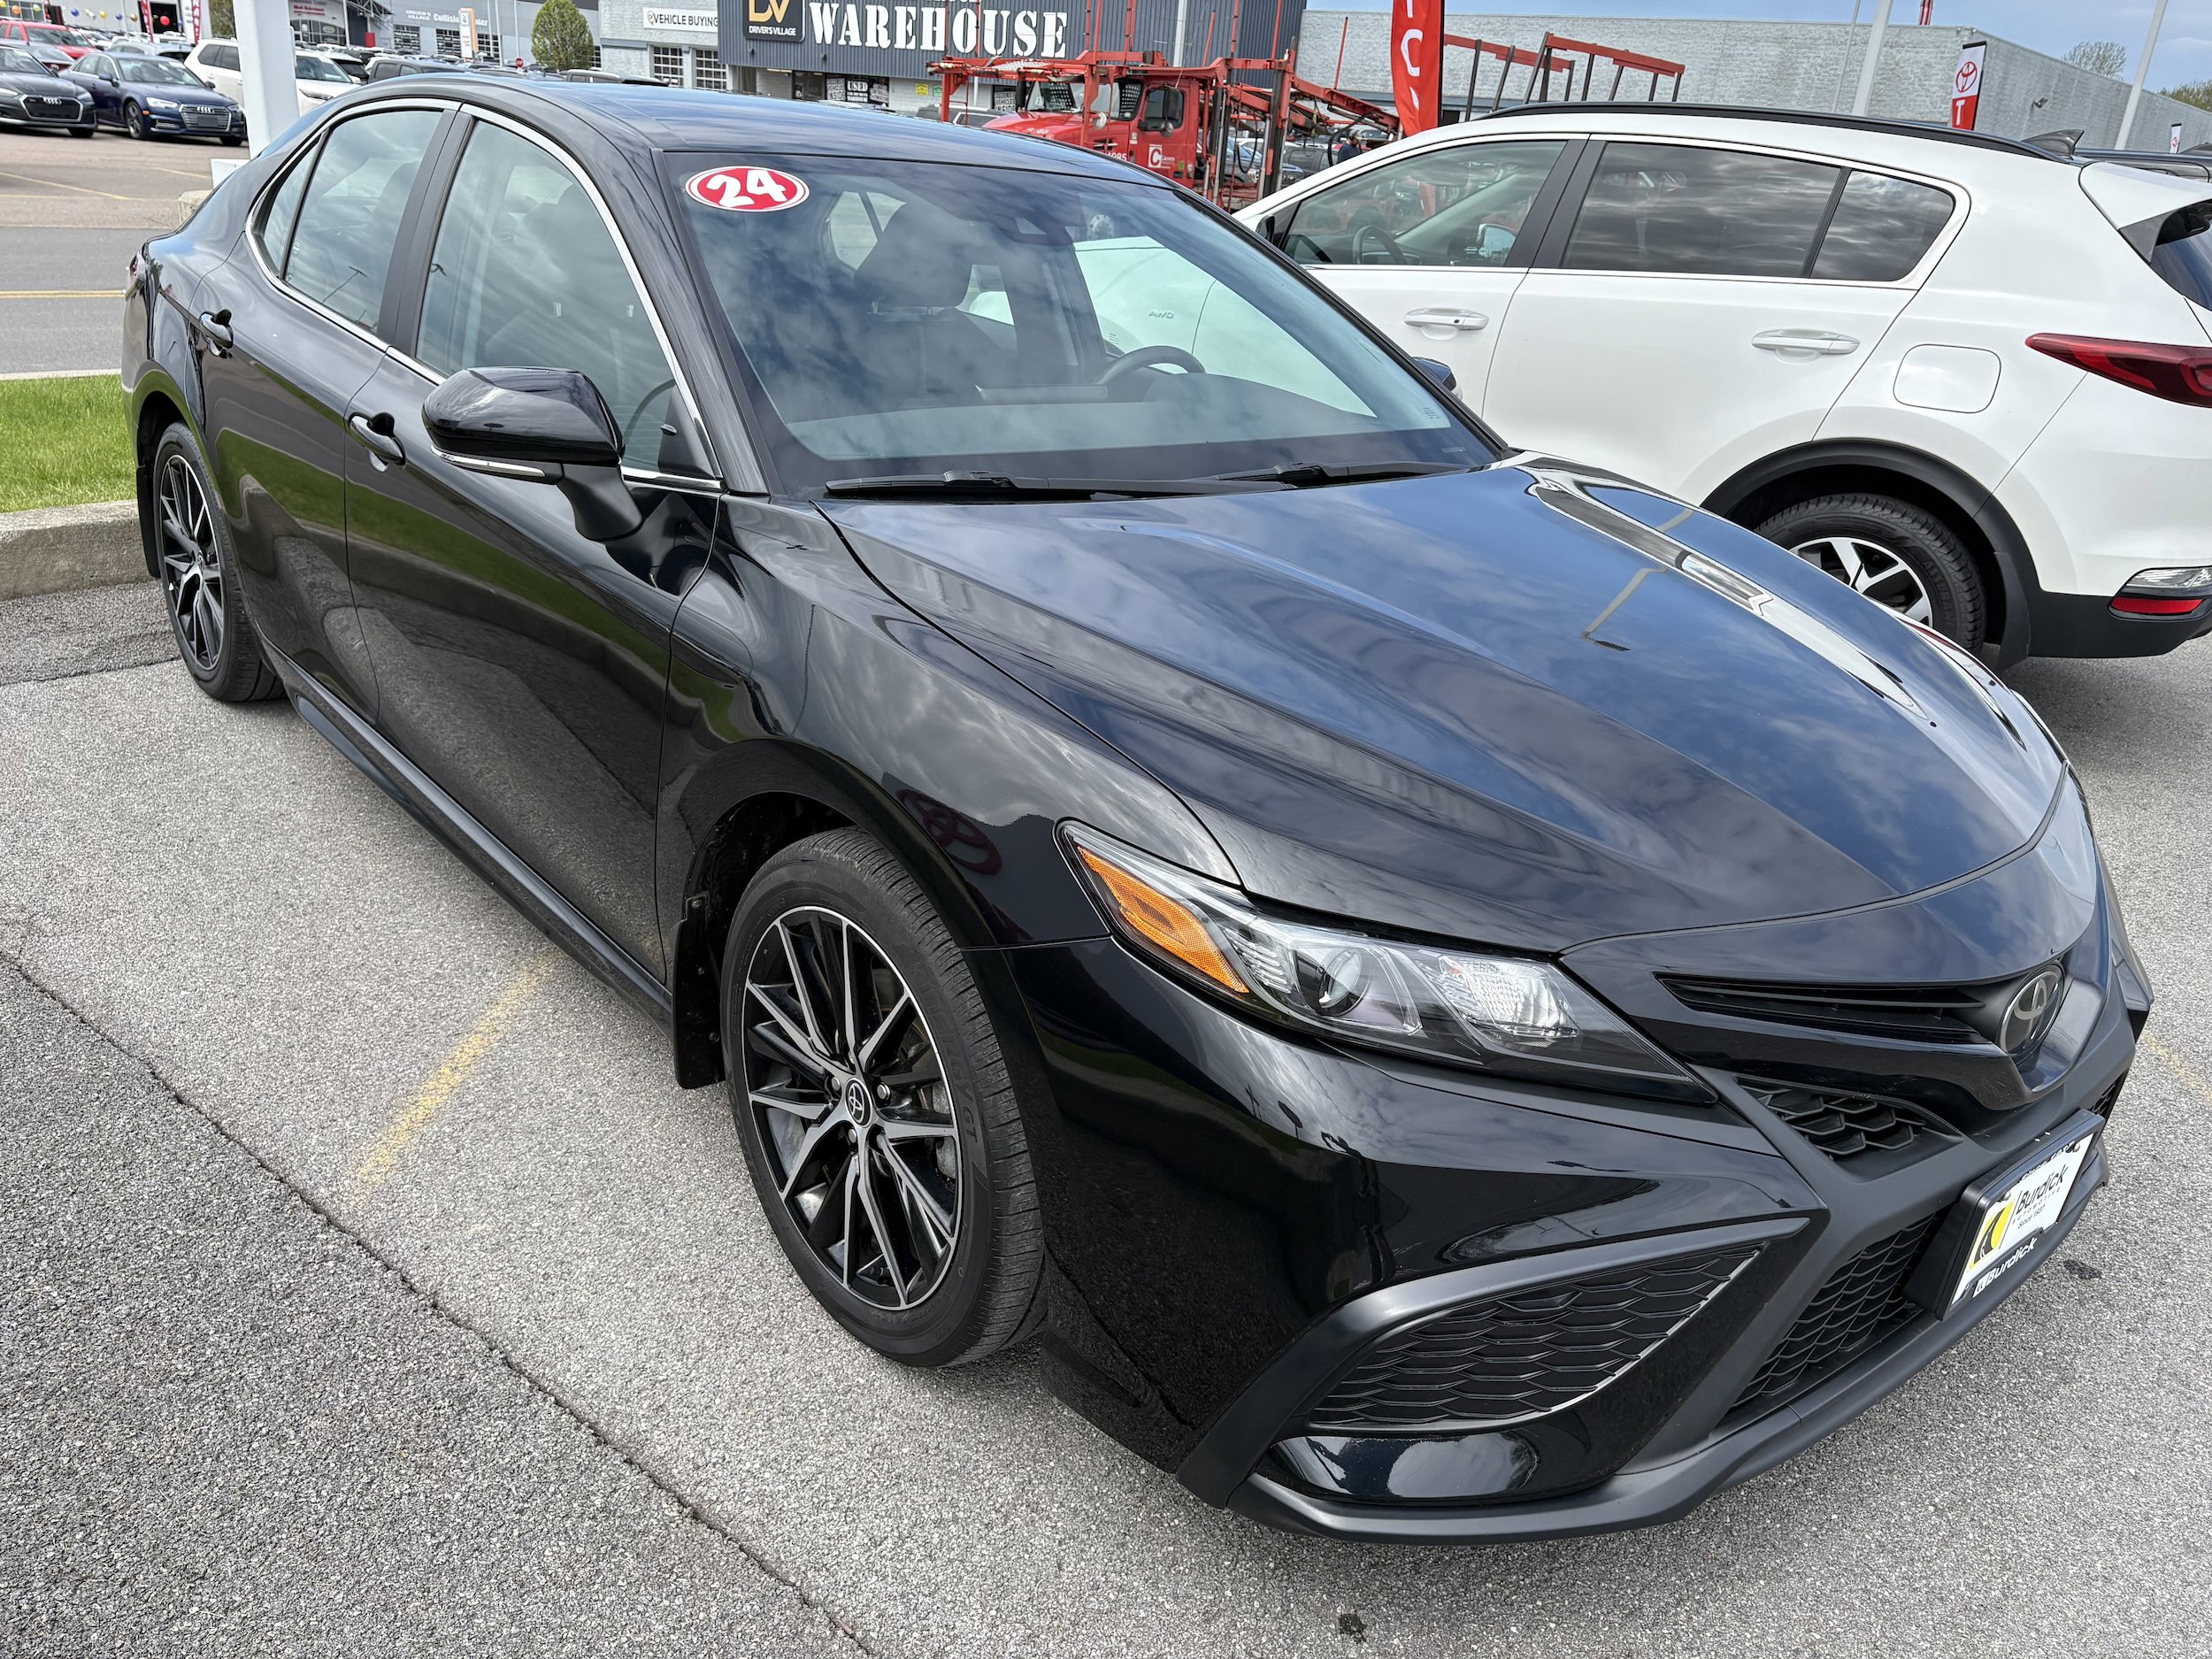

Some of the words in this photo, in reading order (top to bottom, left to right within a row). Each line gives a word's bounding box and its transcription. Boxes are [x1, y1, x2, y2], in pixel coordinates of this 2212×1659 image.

[653, 13, 687, 25] VEHICLE
[688, 16, 718, 27] BUYING
[773, 27, 796, 35] VILLAGE
[809, 2, 1067, 58] WAREHOUSE
[847, 81, 868, 92] USED
[706, 169, 788, 208] 24
[2016, 1164, 2069, 1216] Burdick
[1985, 1237, 2038, 1287] Burdick
